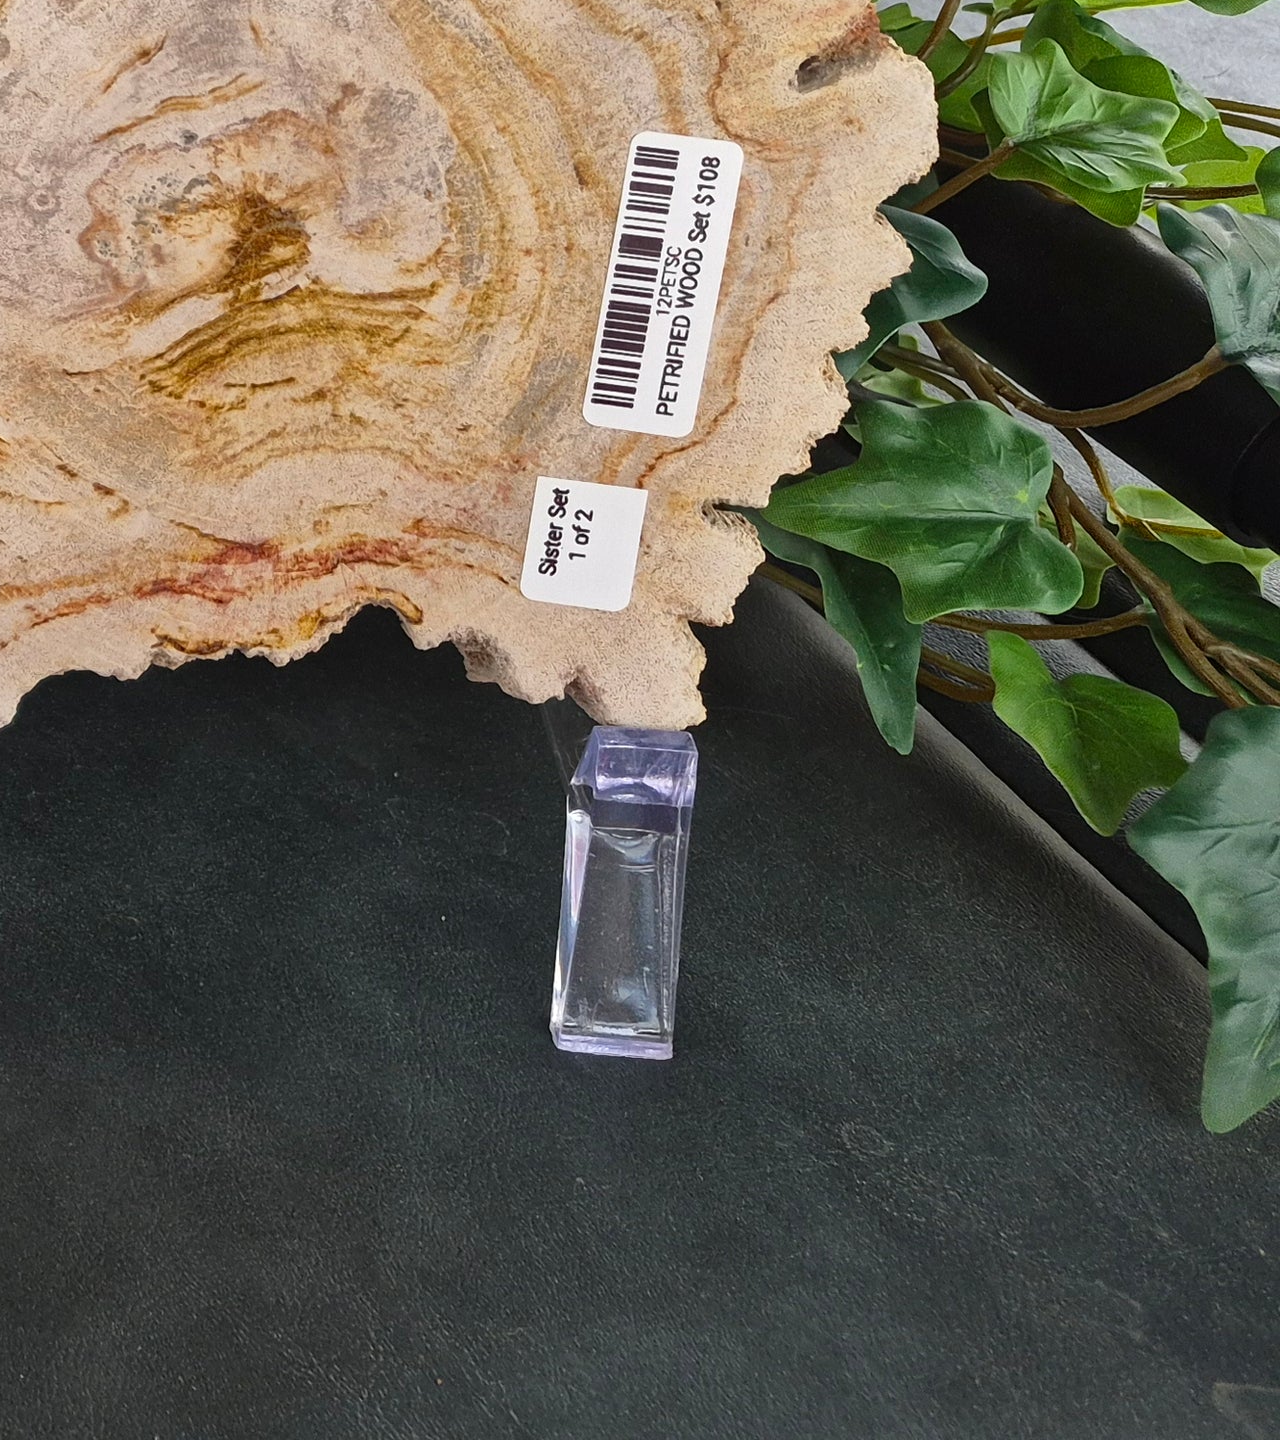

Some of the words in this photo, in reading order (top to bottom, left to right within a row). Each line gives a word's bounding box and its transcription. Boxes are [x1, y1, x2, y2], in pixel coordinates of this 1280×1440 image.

[691, 155, 721, 206] $108
[688, 211, 712, 243] Set
[656, 246, 683, 317] 12PETSC
[674, 247, 704, 310] WOOD
[656, 315, 691, 417] PETRIFIED
[547, 487, 570, 519] Set
[574, 509, 594, 522] 2
[538, 521, 564, 576] Sister
[572, 524, 590, 545] of
[568, 552, 586, 560] 1
